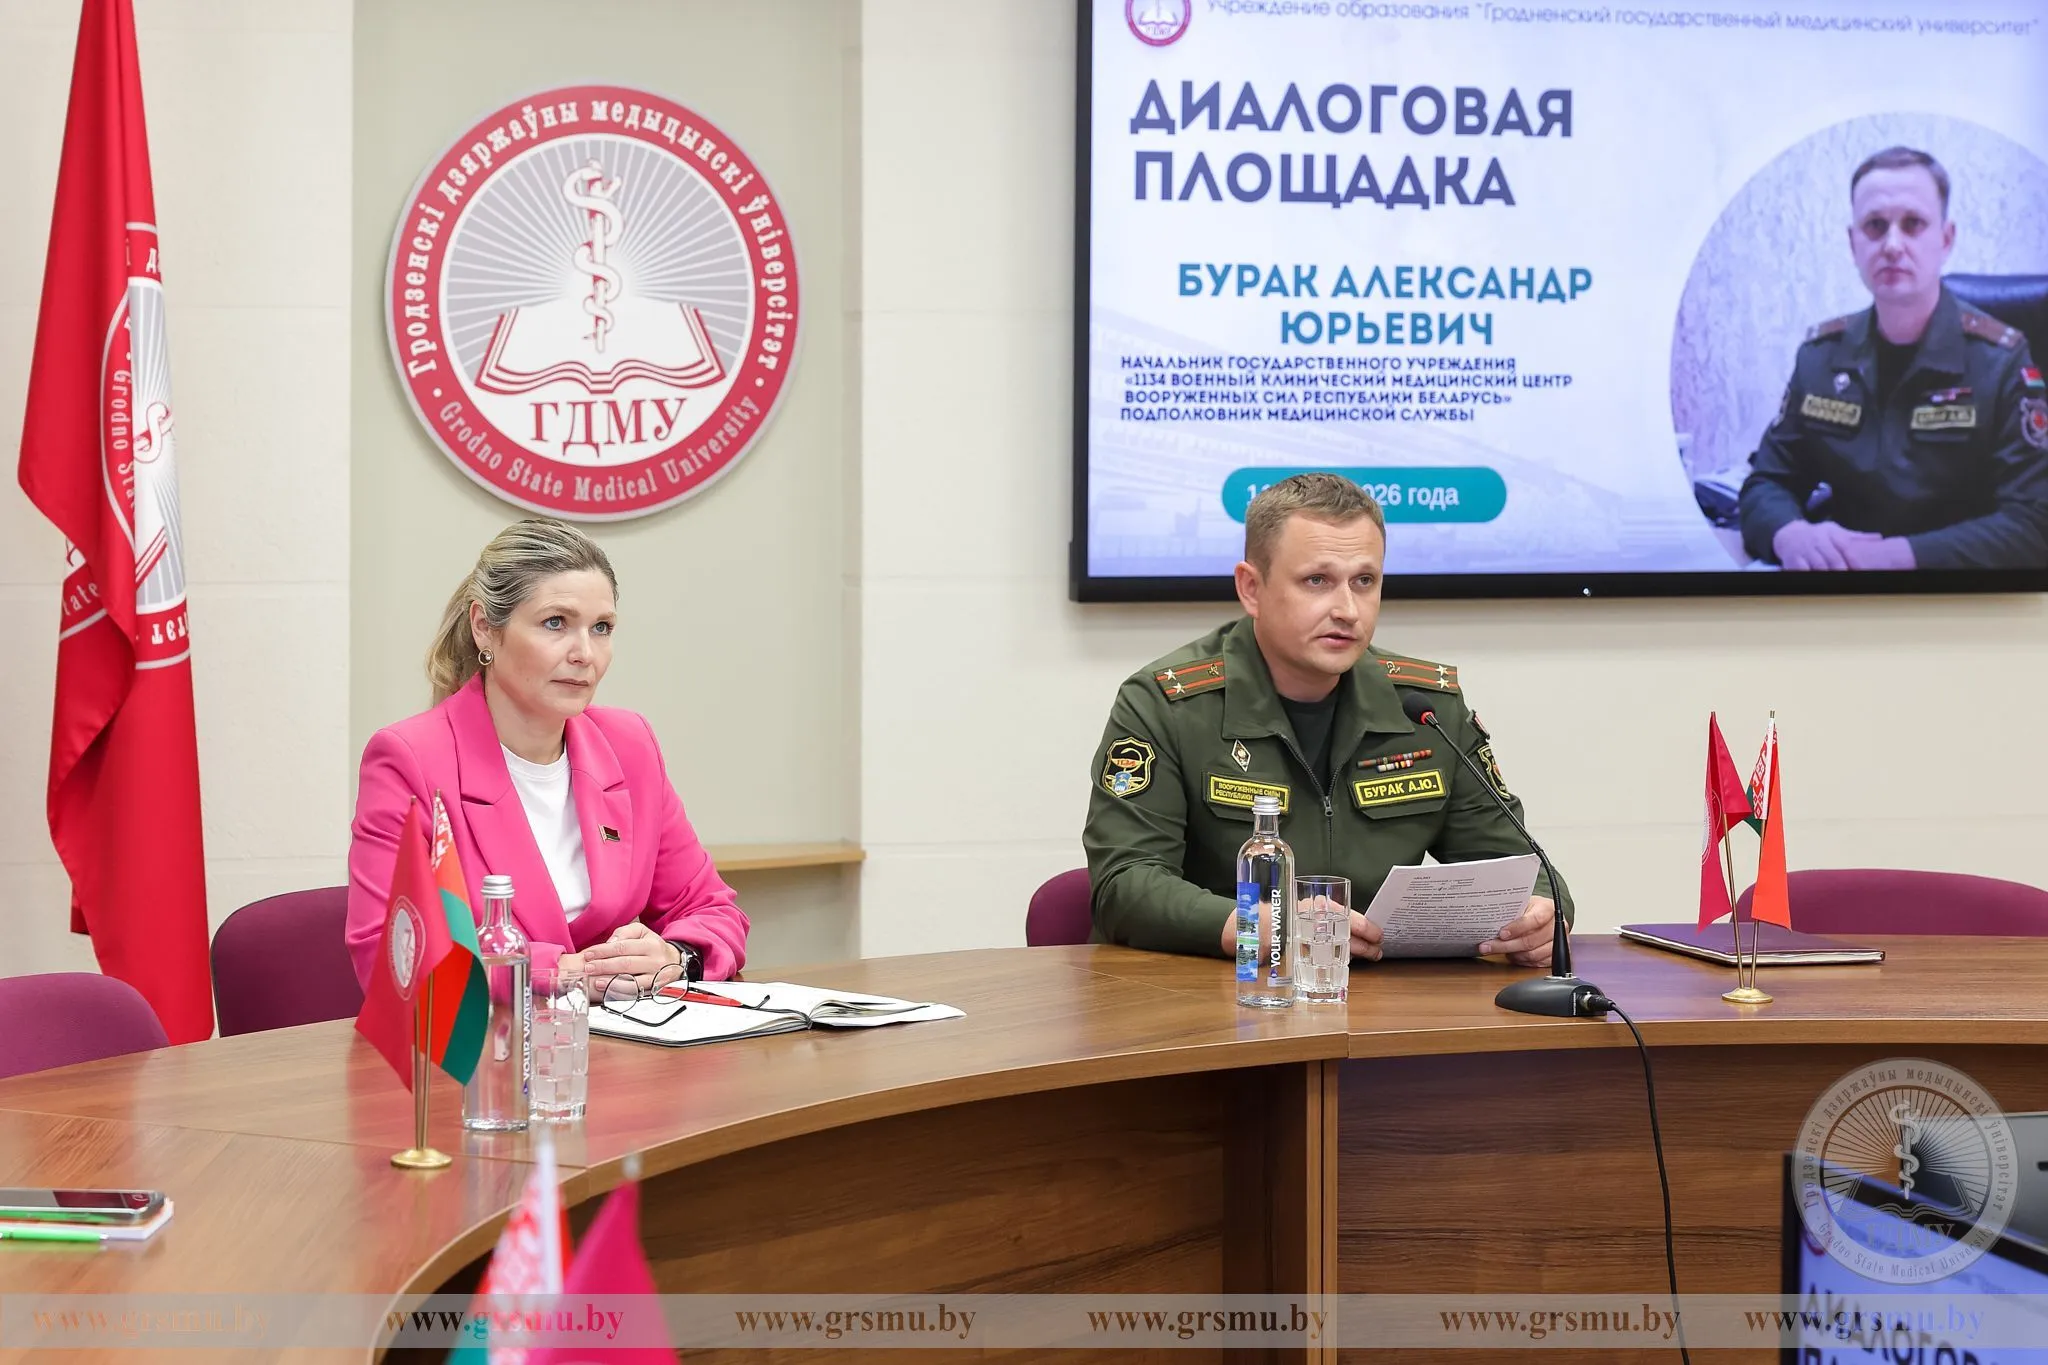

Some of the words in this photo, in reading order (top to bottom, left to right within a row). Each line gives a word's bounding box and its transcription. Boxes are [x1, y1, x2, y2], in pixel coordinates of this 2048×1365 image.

[1336, 1, 1469, 20] образования
[1615, 8, 1781, 28] государственный
[1786, 13, 1912, 34] медицинский
[1130, 79, 1573, 138] ДИАЛОГОВАЯ
[1134, 151, 1516, 210] ПЛОЩАДКА
[405, 201, 446, 379] Гродзенскі
[437, 99, 580, 206] дзяржаўны
[591, 99, 755, 196] медыцынскі
[738, 193, 794, 371] ўніверсітэт
[1179, 263, 1319, 298] БУРАК
[1331, 264, 1593, 304] АЛЕКСАНДР
[1281, 311, 1493, 346] ЮРЬЕВИЧ
[1121, 356, 1223, 370] НАЧАЛЬНИК
[1228, 356, 1402, 371] ГОСУДАРСТВЕННОГО
[1407, 357, 1516, 371] УЧРЕЖДЕНИЯ
[1125, 373, 1166, 387] «1134
[1171, 370, 1256, 387] ВОЕННЫЙ
[1261, 370, 1386, 387] КЛИНИЧЕСКИЙ
[1391, 371, 1517, 388] МЕДИЦИНСКИЙ
[1522, 374, 1573, 388] ЦЕНТР
[110, 369, 132, 450] Grodno
[1121, 407, 1262, 422] ПОДПОЛКОВНИК
[1267, 405, 1396, 422] МЕДИЦИНСКОЙ
[1400, 408, 1474, 422] СЛУЖБЫ
[1125, 390, 1258, 404] ВООРУЖЕННЫХ
[1263, 390, 1298, 404] СИЛ
[1303, 390, 1413, 405] РЕСПУБЛИКИ
[1418, 391, 1512, 405] БЕЛАРУСЬ»
[530, 397, 687, 458] ГДМУ
[440, 399, 502, 471] Grodno
[506, 457, 564, 499] State
[574, 467, 658, 502] Medical
[662, 396, 762, 485] University
[1363, 484, 1401, 506] 026
[1408, 486, 1460, 511] года
[1218, 782, 1263, 795] ВООРУЖЕННЫЕ
[1263, 789, 1281, 798] СИЛЫ
[1363, 782, 1405, 799] БУРАК
[1408, 778, 1437, 792] А.Ю.
[1271, 888, 1281, 934] WATER
[1270, 935, 1281, 968] YOUR
[523, 1042, 531, 1081] YOUR
